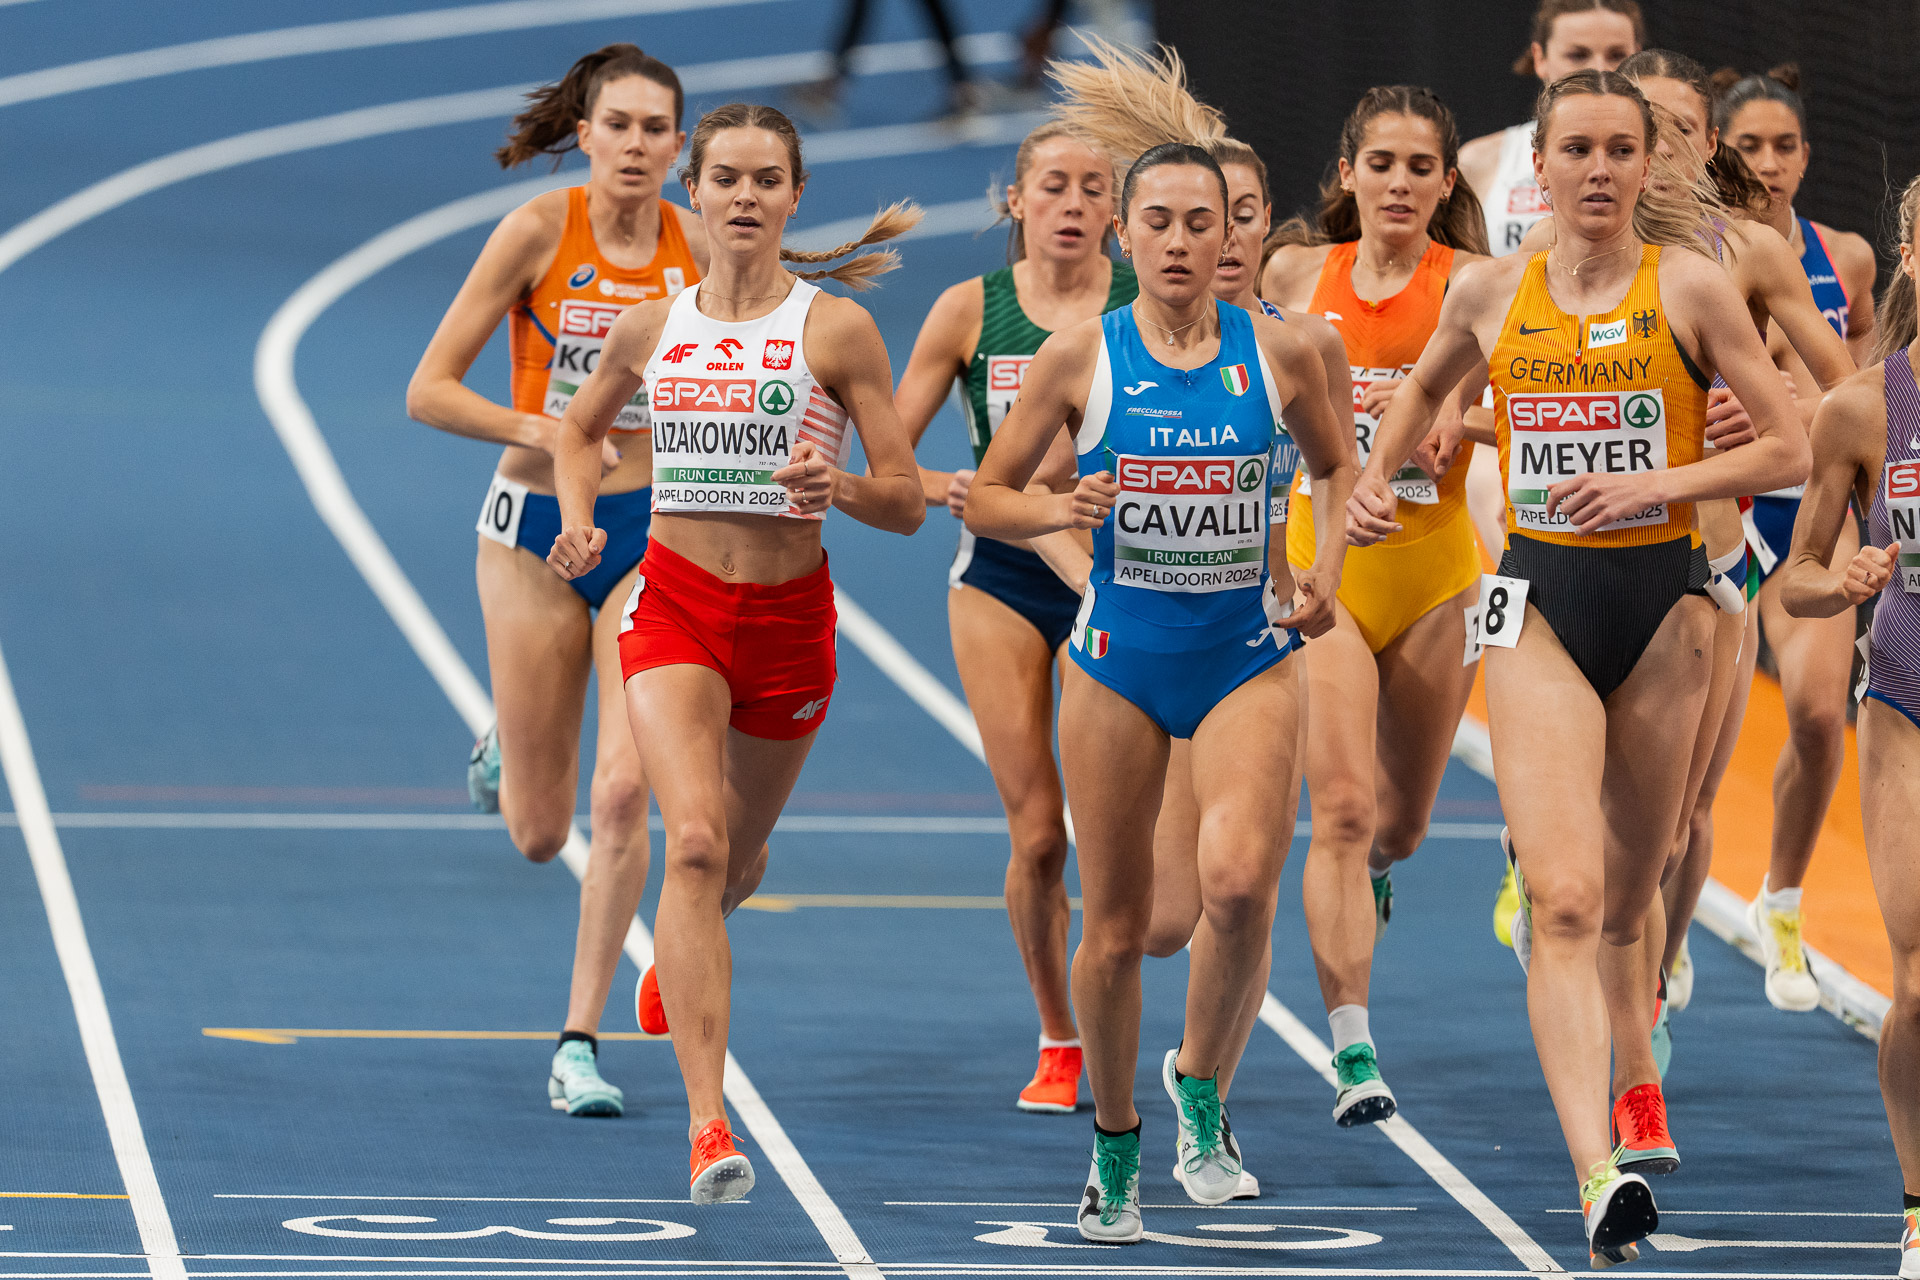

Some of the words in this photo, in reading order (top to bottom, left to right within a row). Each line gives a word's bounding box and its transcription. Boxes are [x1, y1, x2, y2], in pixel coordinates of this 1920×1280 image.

[566, 308, 616, 335] SP
[1590, 324, 1625, 343] WGV
[706, 362, 744, 371] ORLEN
[1510, 355, 1652, 386] GERMANY
[655, 381, 753, 408] SPAR
[1126, 407, 1183, 416] FRECCIAROSSA
[1512, 400, 1618, 427] SPAR
[653, 421, 789, 457] LIZAKOWSKA
[1150, 424, 1239, 447] ITALIA
[1271, 443, 1301, 475] ANT
[1520, 438, 1654, 475] MEYER
[673, 469, 676, 480] I
[678, 469, 705, 481] RUN
[1122, 463, 1232, 490] SPAR
[658, 489, 744, 504] APELDOORN
[749, 492, 786, 505] 2025
[1397, 485, 1432, 499] 2025
[1118, 500, 1260, 538] CAVALLI
[1147, 550, 1151, 562] I
[1154, 551, 1183, 564] RUN
[1119, 566, 1223, 586] APELDOORN
[1224, 567, 1259, 585] 2025
[1485, 587, 1508, 636] 8
[282, 1214, 697, 1242] 3
